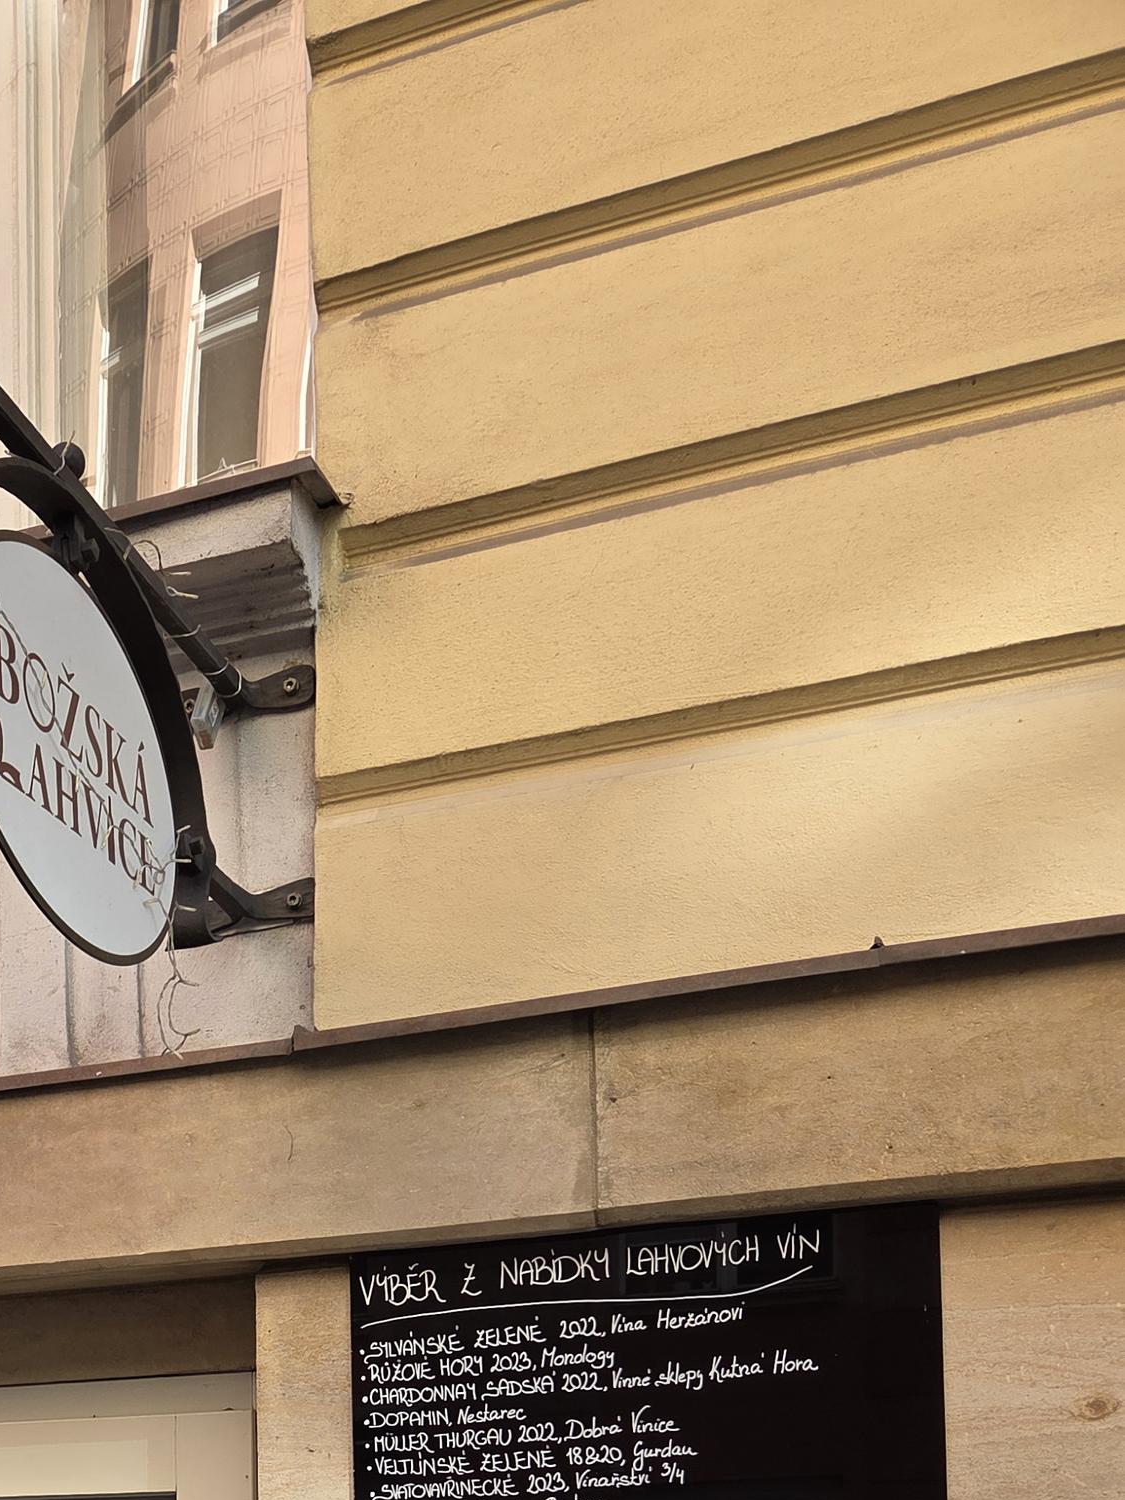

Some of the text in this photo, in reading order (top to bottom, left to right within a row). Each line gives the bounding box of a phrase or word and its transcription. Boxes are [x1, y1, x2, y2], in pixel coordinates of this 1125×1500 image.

[359, 1223, 820, 1306] VÝBĚR Z NABÍDKY LAHVOVÝCH VÍN
[364, 1325, 464, 1364] SYLVÁNSKÉ
[474, 1315, 547, 1348] ZELENÉ
[560, 1317, 606, 1339] 2022,
[611, 1313, 647, 1335] Vína
[369, 1349, 819, 1407] CHARDONNAY SADSKÁ 2022, Vinné sklepy Kutná Hora
[440, 1355, 483, 1377] HORY
[490, 1353, 536, 1373] 2023,
[540, 1343, 615, 1369] Monology
[368, 1404, 527, 1429] DOPAMIN, Nestarec
[374, 1405, 680, 1453] MÜLLER THURGAU 2022, Dobrá Vinice
[375, 1450, 474, 1475] VELTLÍNSKÉ
[480, 1444, 557, 1471] ZELENÉ
[633, 1439, 698, 1471] Gurdau
[526, 1473, 570, 1494] 2023,
[575, 1466, 653, 1490] Vinařství
[661, 1462, 685, 1485] 3/4
